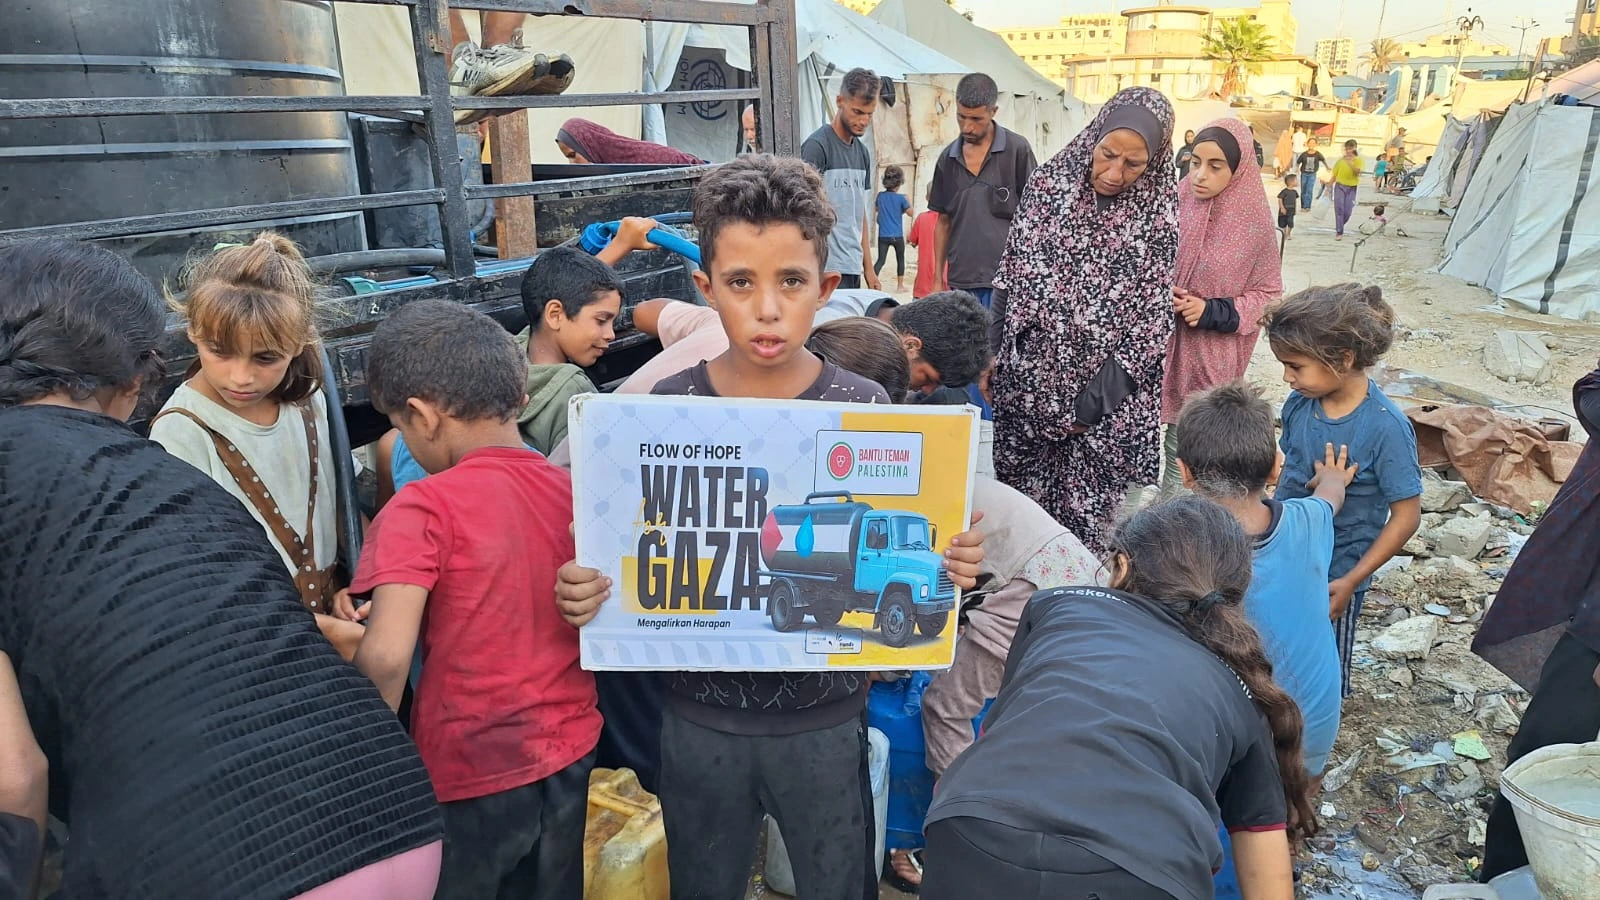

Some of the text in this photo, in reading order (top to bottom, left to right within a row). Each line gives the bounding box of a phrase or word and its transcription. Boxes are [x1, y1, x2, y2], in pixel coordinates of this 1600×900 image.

[639, 443, 742, 460] FLOW OF HOPE
[858, 448, 910, 463] BANTU TEMAN
[857, 464, 909, 478] PALESTINA
[640, 464, 770, 529] WATER
[637, 529, 761, 611] GAZA
[637, 618, 731, 631] Mengalirkan Harapan
